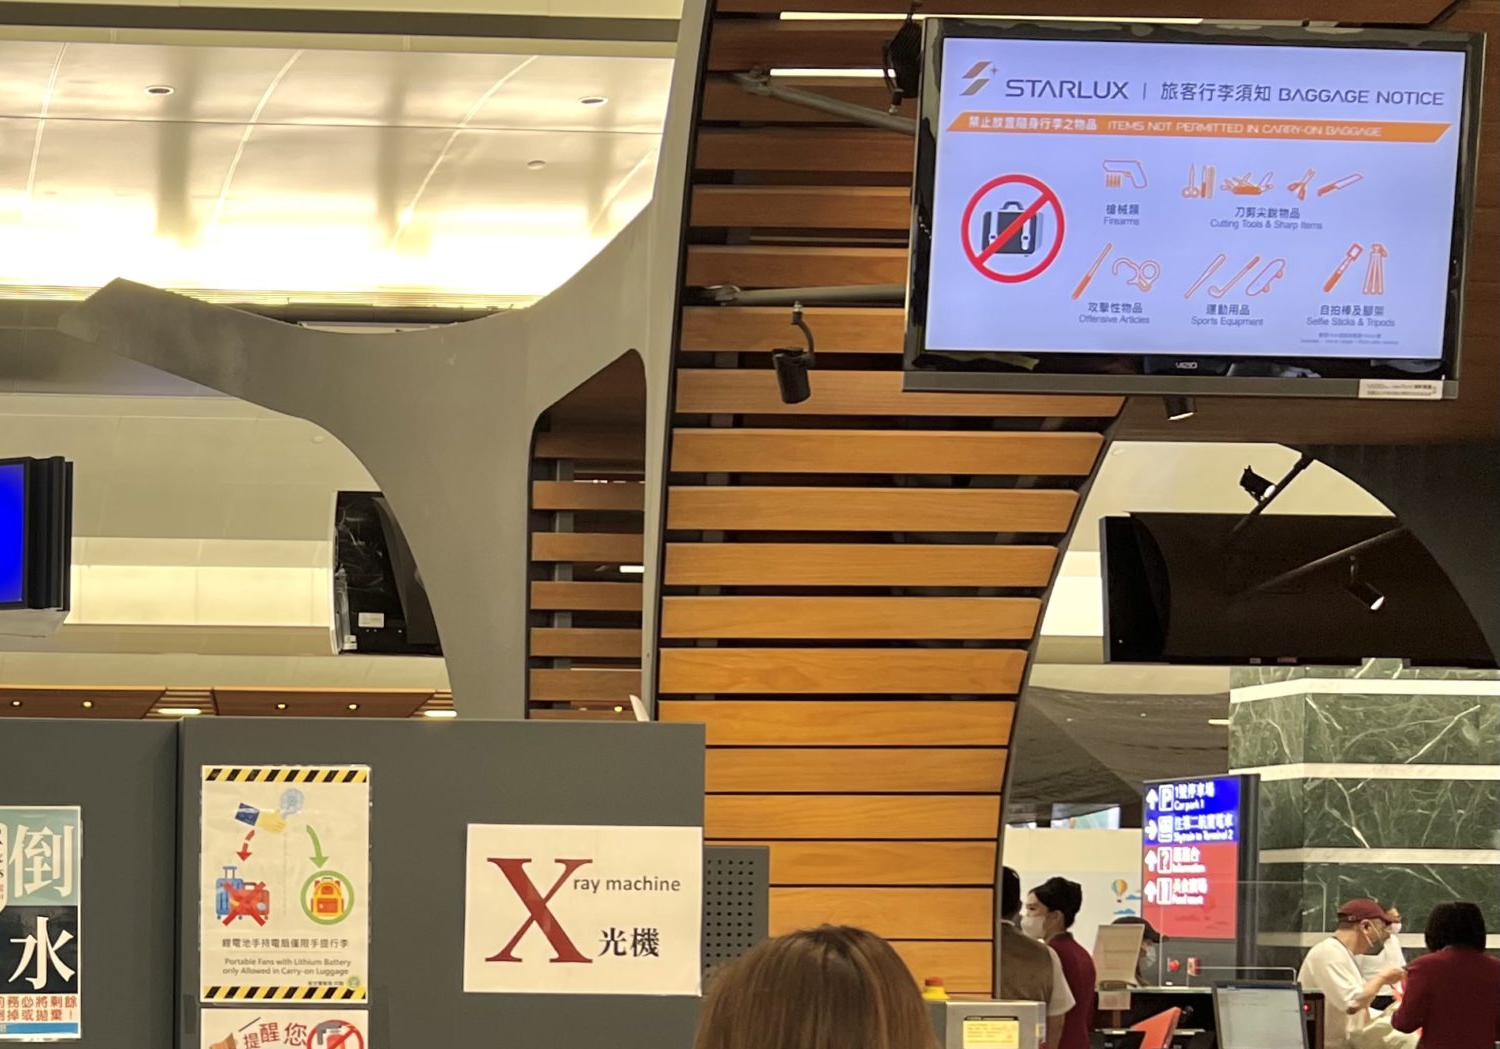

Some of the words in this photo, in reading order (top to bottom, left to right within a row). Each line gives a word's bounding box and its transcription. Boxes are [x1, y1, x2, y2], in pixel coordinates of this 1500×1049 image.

[1005, 79, 1129, 99] STARLUX
[1160, 81, 1271, 101] 旅客行李須知
[1278, 88, 1370, 104] BAGGAGE
[1376, 91, 1444, 106] NOTICE
[1108, 121, 1145, 131] ITEMS
[1148, 121, 1171, 131] NOT
[1176, 122, 1243, 133] PERMITTED
[1247, 124, 1258, 133] IN
[1262, 124, 1323, 135] CARRY-ON
[1326, 126, 1381, 137] BAGGAGE
[1103, 216, 1139, 226] Firearms
[1210, 218, 1239, 230] Cutting
[1242, 219, 1263, 229] Tools
[1265, 219, 1271, 229] &
[1274, 220, 1298, 231] Sharp
[1300, 221, 1322, 230] Items
[1088, 302, 1143, 314] 攻擊性物品
[1206, 303, 1250, 316] 運動用品
[1320, 304, 1384, 316] 自拍棒及腳架
[1078, 314, 1117, 324] Offensive
[1119, 314, 1150, 324] Articles
[1191, 316, 1218, 326] Sports
[1220, 316, 1264, 327] Equipment
[1307, 317, 1329, 326] Selfie
[1331, 317, 1355, 327] Sticks
[1357, 317, 1364, 327] &
[1367, 317, 1395, 328] Tripods
[485, 857, 593, 963] X
[573, 878, 600, 894] ray
[606, 876, 681, 892] machine
[599, 928, 660, 957] 光機
[225, 958, 256, 966] Portable
[258, 958, 274, 966] Fans
[276, 957, 292, 966] with
[294, 957, 322, 966] Lithium
[324, 958, 351, 969] Battery
[222, 967, 239, 977] only
[241, 967, 271, 975] Allowed
[272, 967, 279, 975] in
[316, 967, 349, 978] Luggage
